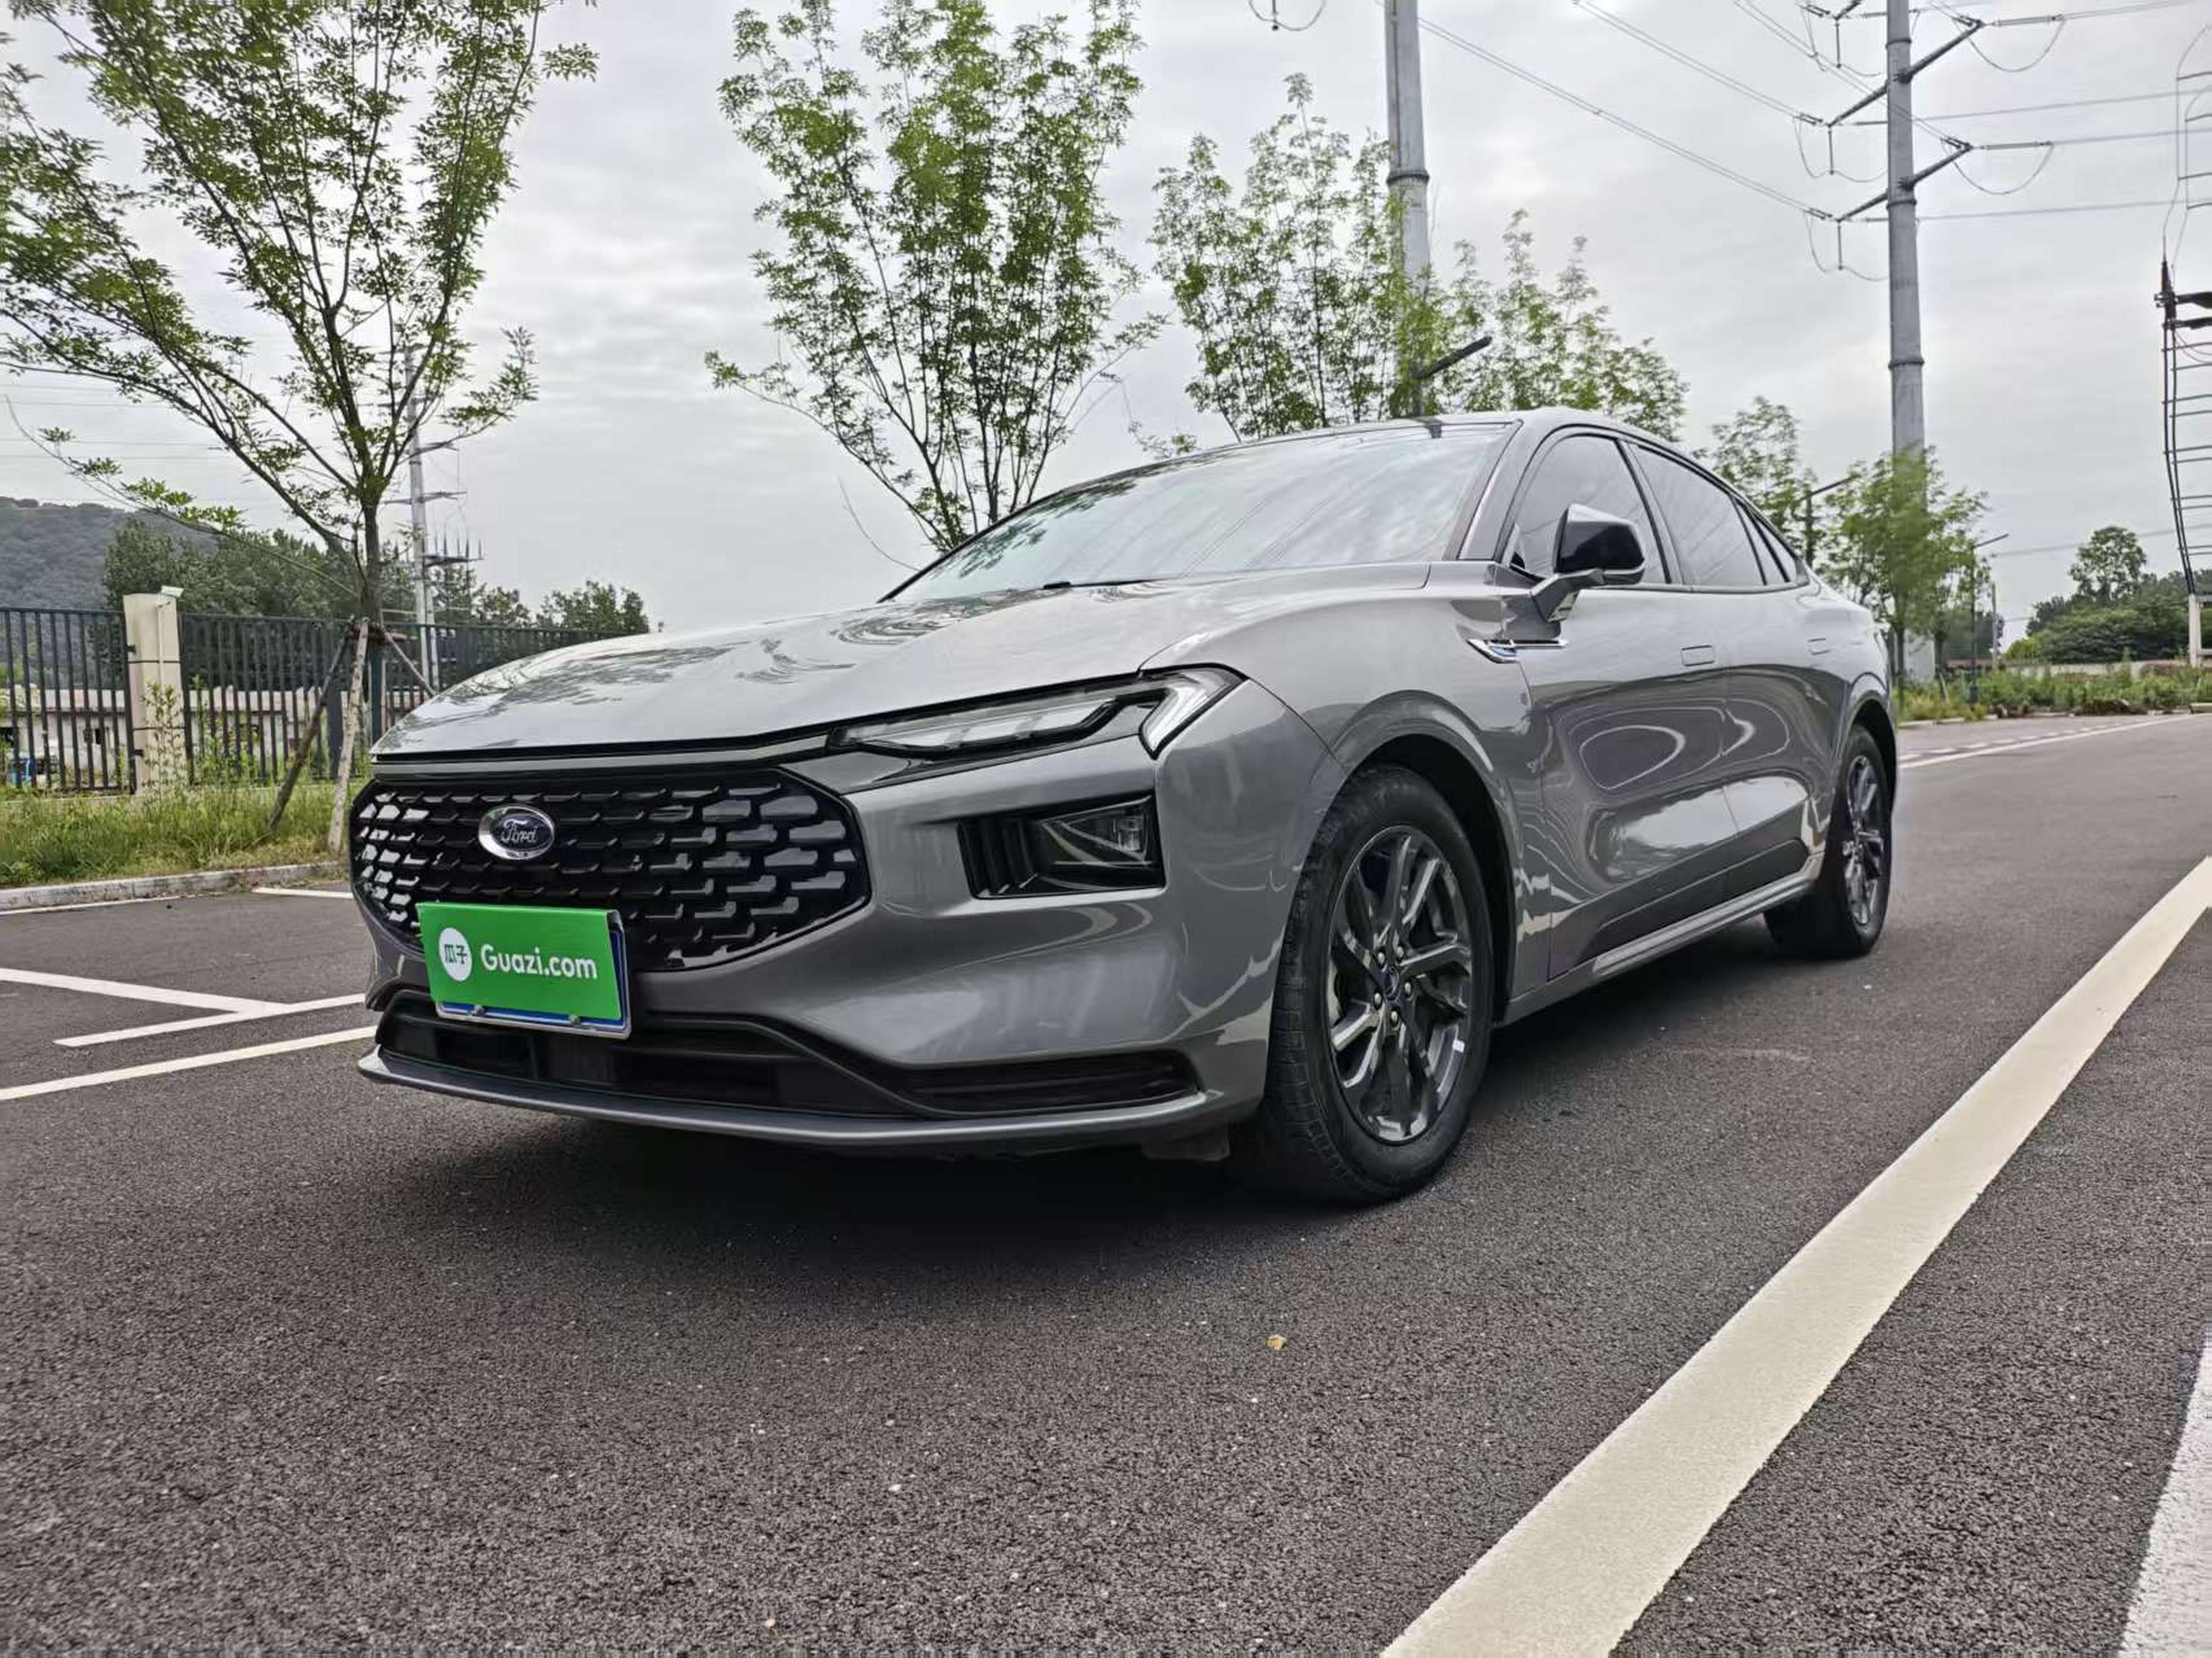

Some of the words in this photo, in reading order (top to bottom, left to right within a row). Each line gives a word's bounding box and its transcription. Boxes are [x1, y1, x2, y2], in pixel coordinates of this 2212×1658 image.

[500, 818, 538, 843] Ford
[444, 943, 468, 965] 瓜子
[480, 943, 598, 979] Guazi.com
